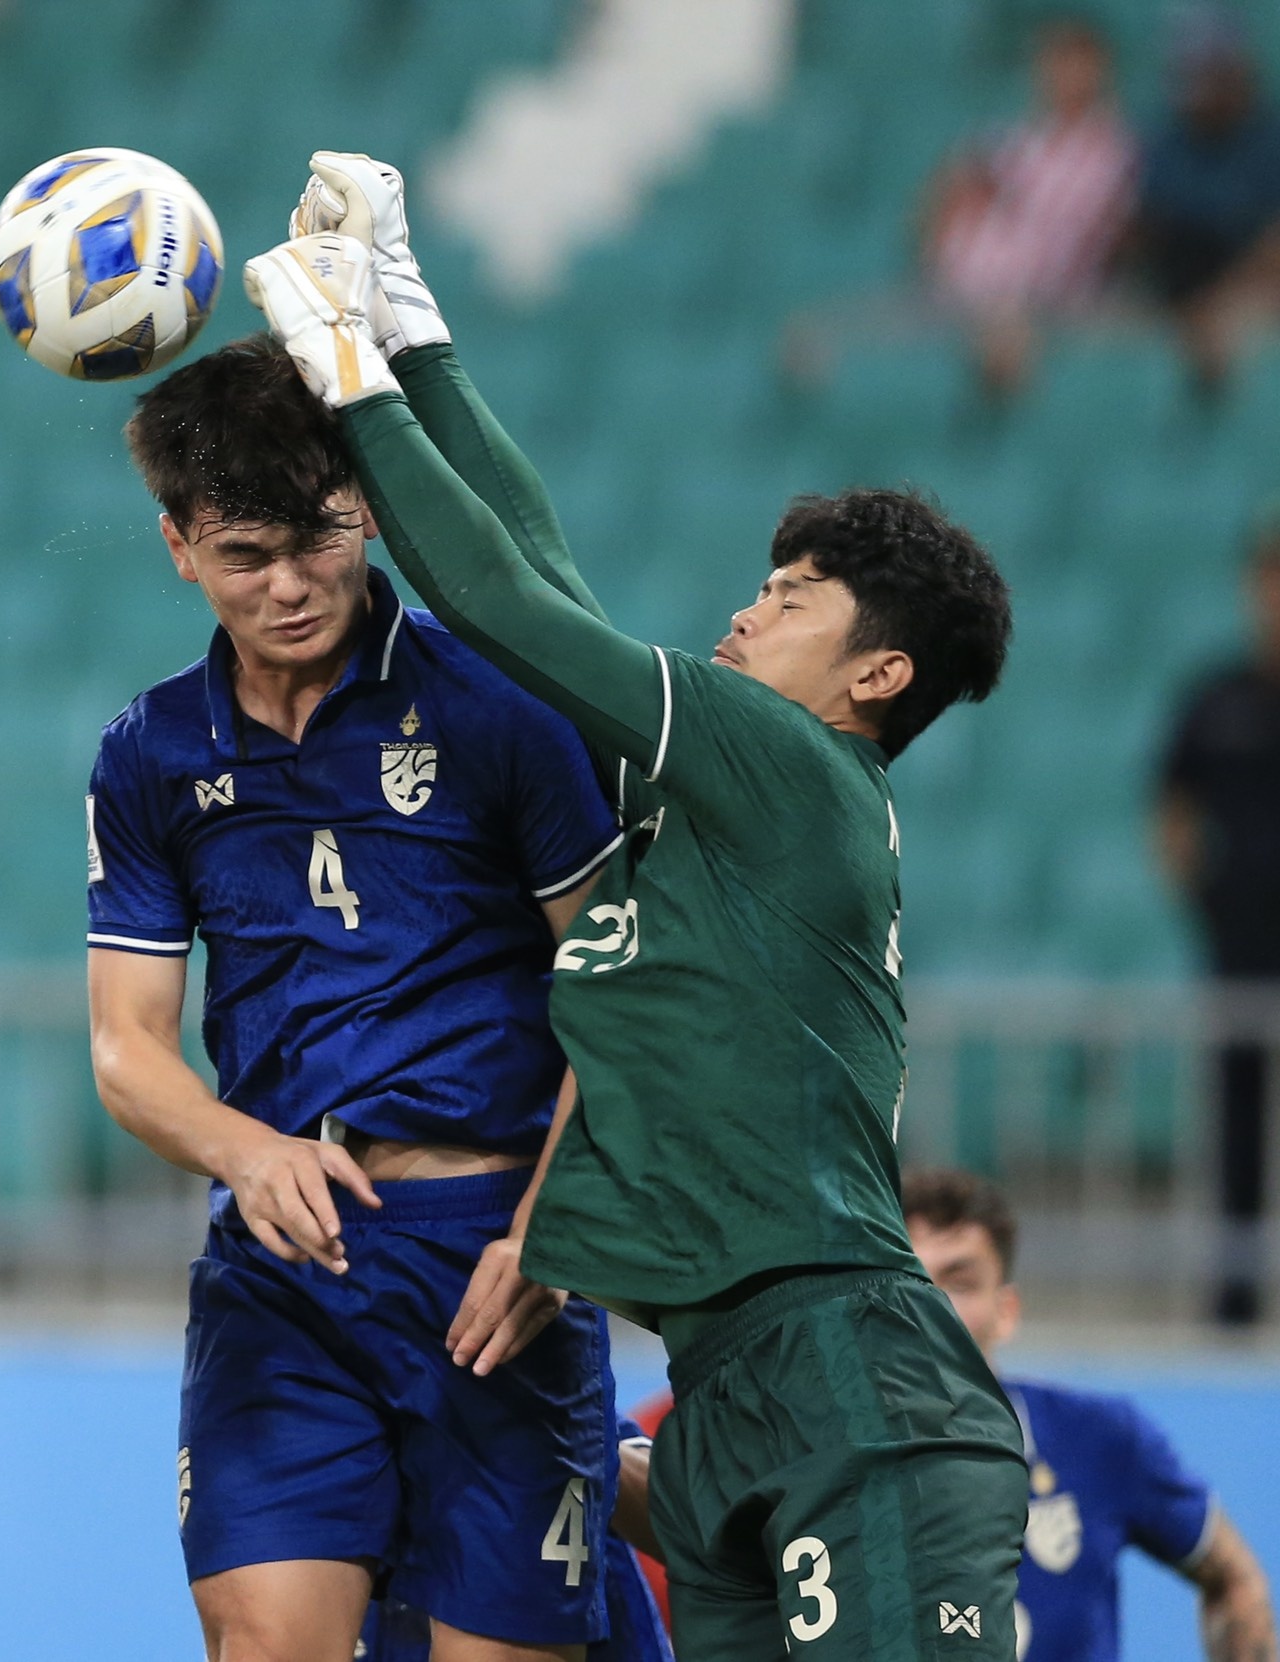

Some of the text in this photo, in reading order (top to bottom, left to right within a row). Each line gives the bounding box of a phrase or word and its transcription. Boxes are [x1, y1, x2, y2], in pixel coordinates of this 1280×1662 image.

[308, 828, 361, 931] 4
[541, 1477, 589, 1587] 4
[781, 1536, 839, 1655] 3
